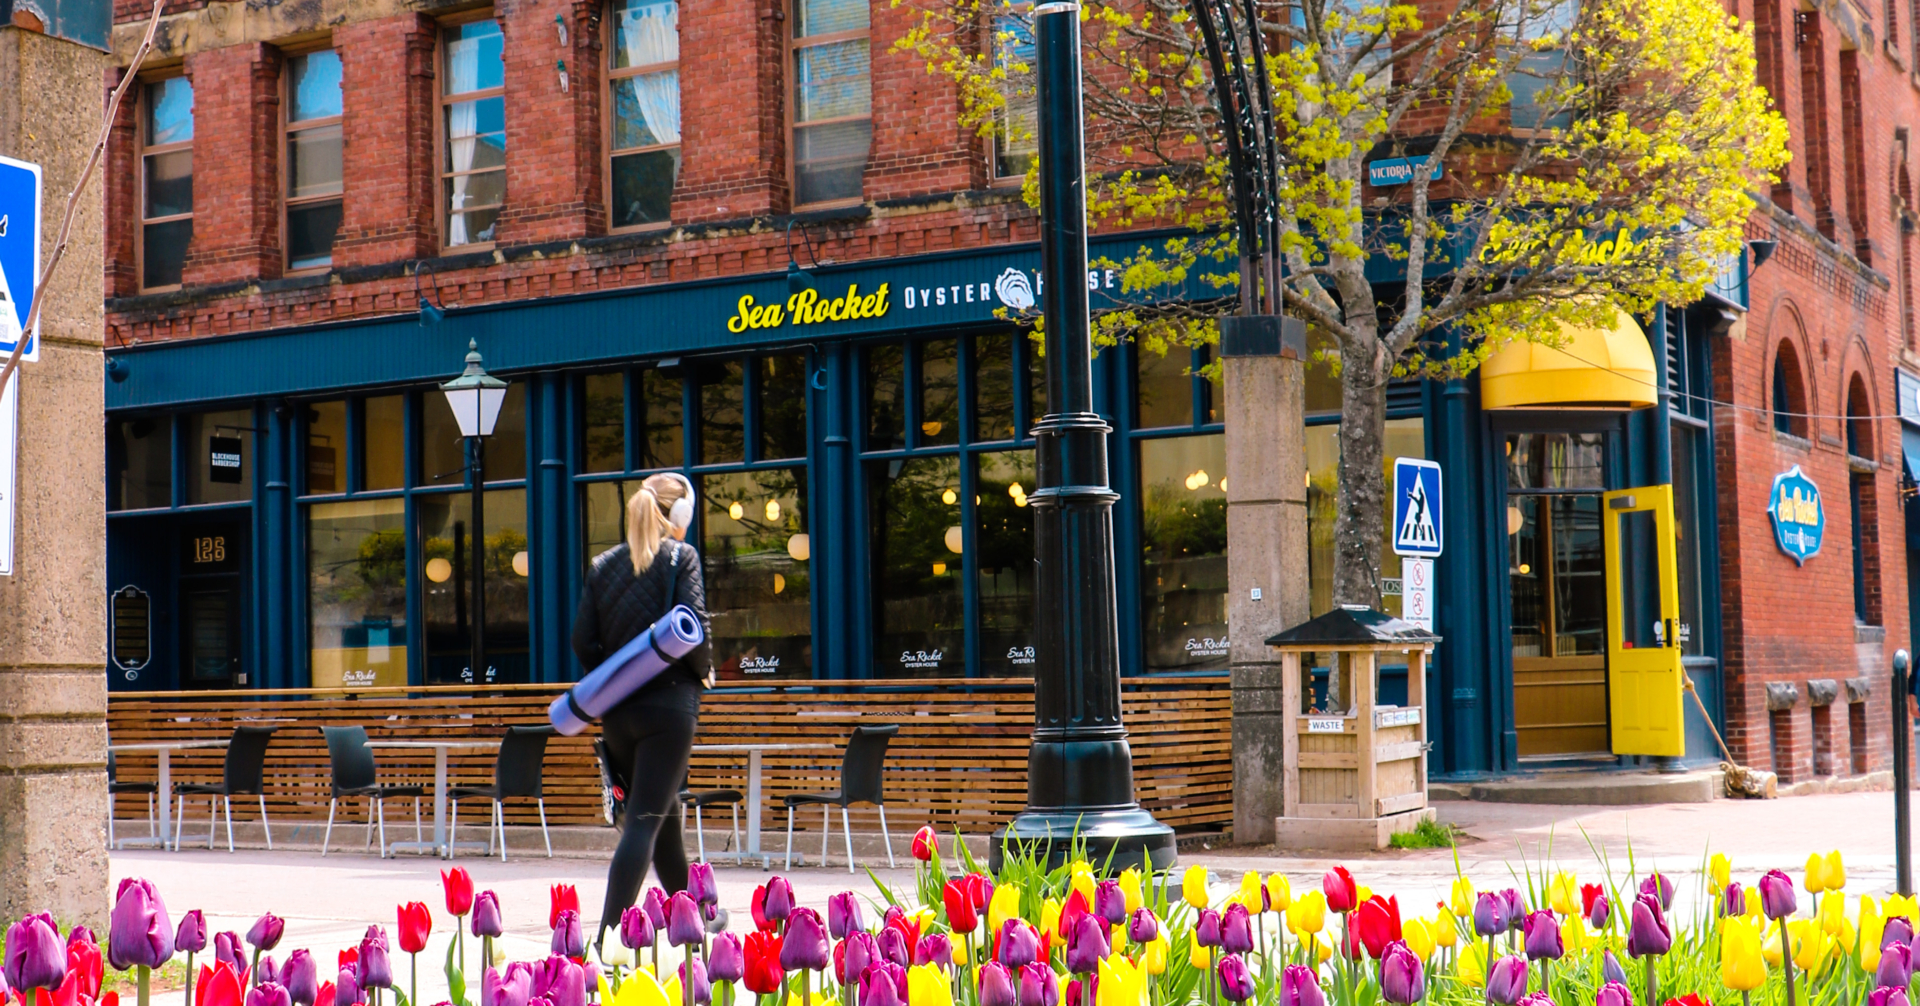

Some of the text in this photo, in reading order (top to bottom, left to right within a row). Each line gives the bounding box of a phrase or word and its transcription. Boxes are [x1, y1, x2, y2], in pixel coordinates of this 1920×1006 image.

[1371, 164, 1412, 179] VICTORIA
[727, 269, 1115, 333] Sea Rocket OYSTER HSE
[1778, 483, 1818, 527] Sea Rocket
[194, 536, 225, 563] 126
[1185, 636, 1230, 650] Sea Rocke
[900, 649, 943, 663] Sea Rocket
[1006, 646, 1024, 659] Sea
[739, 655, 780, 669] Sea Rocket
[342, 670, 355, 682] Sea
[1312, 720, 1340, 730] WASTE
